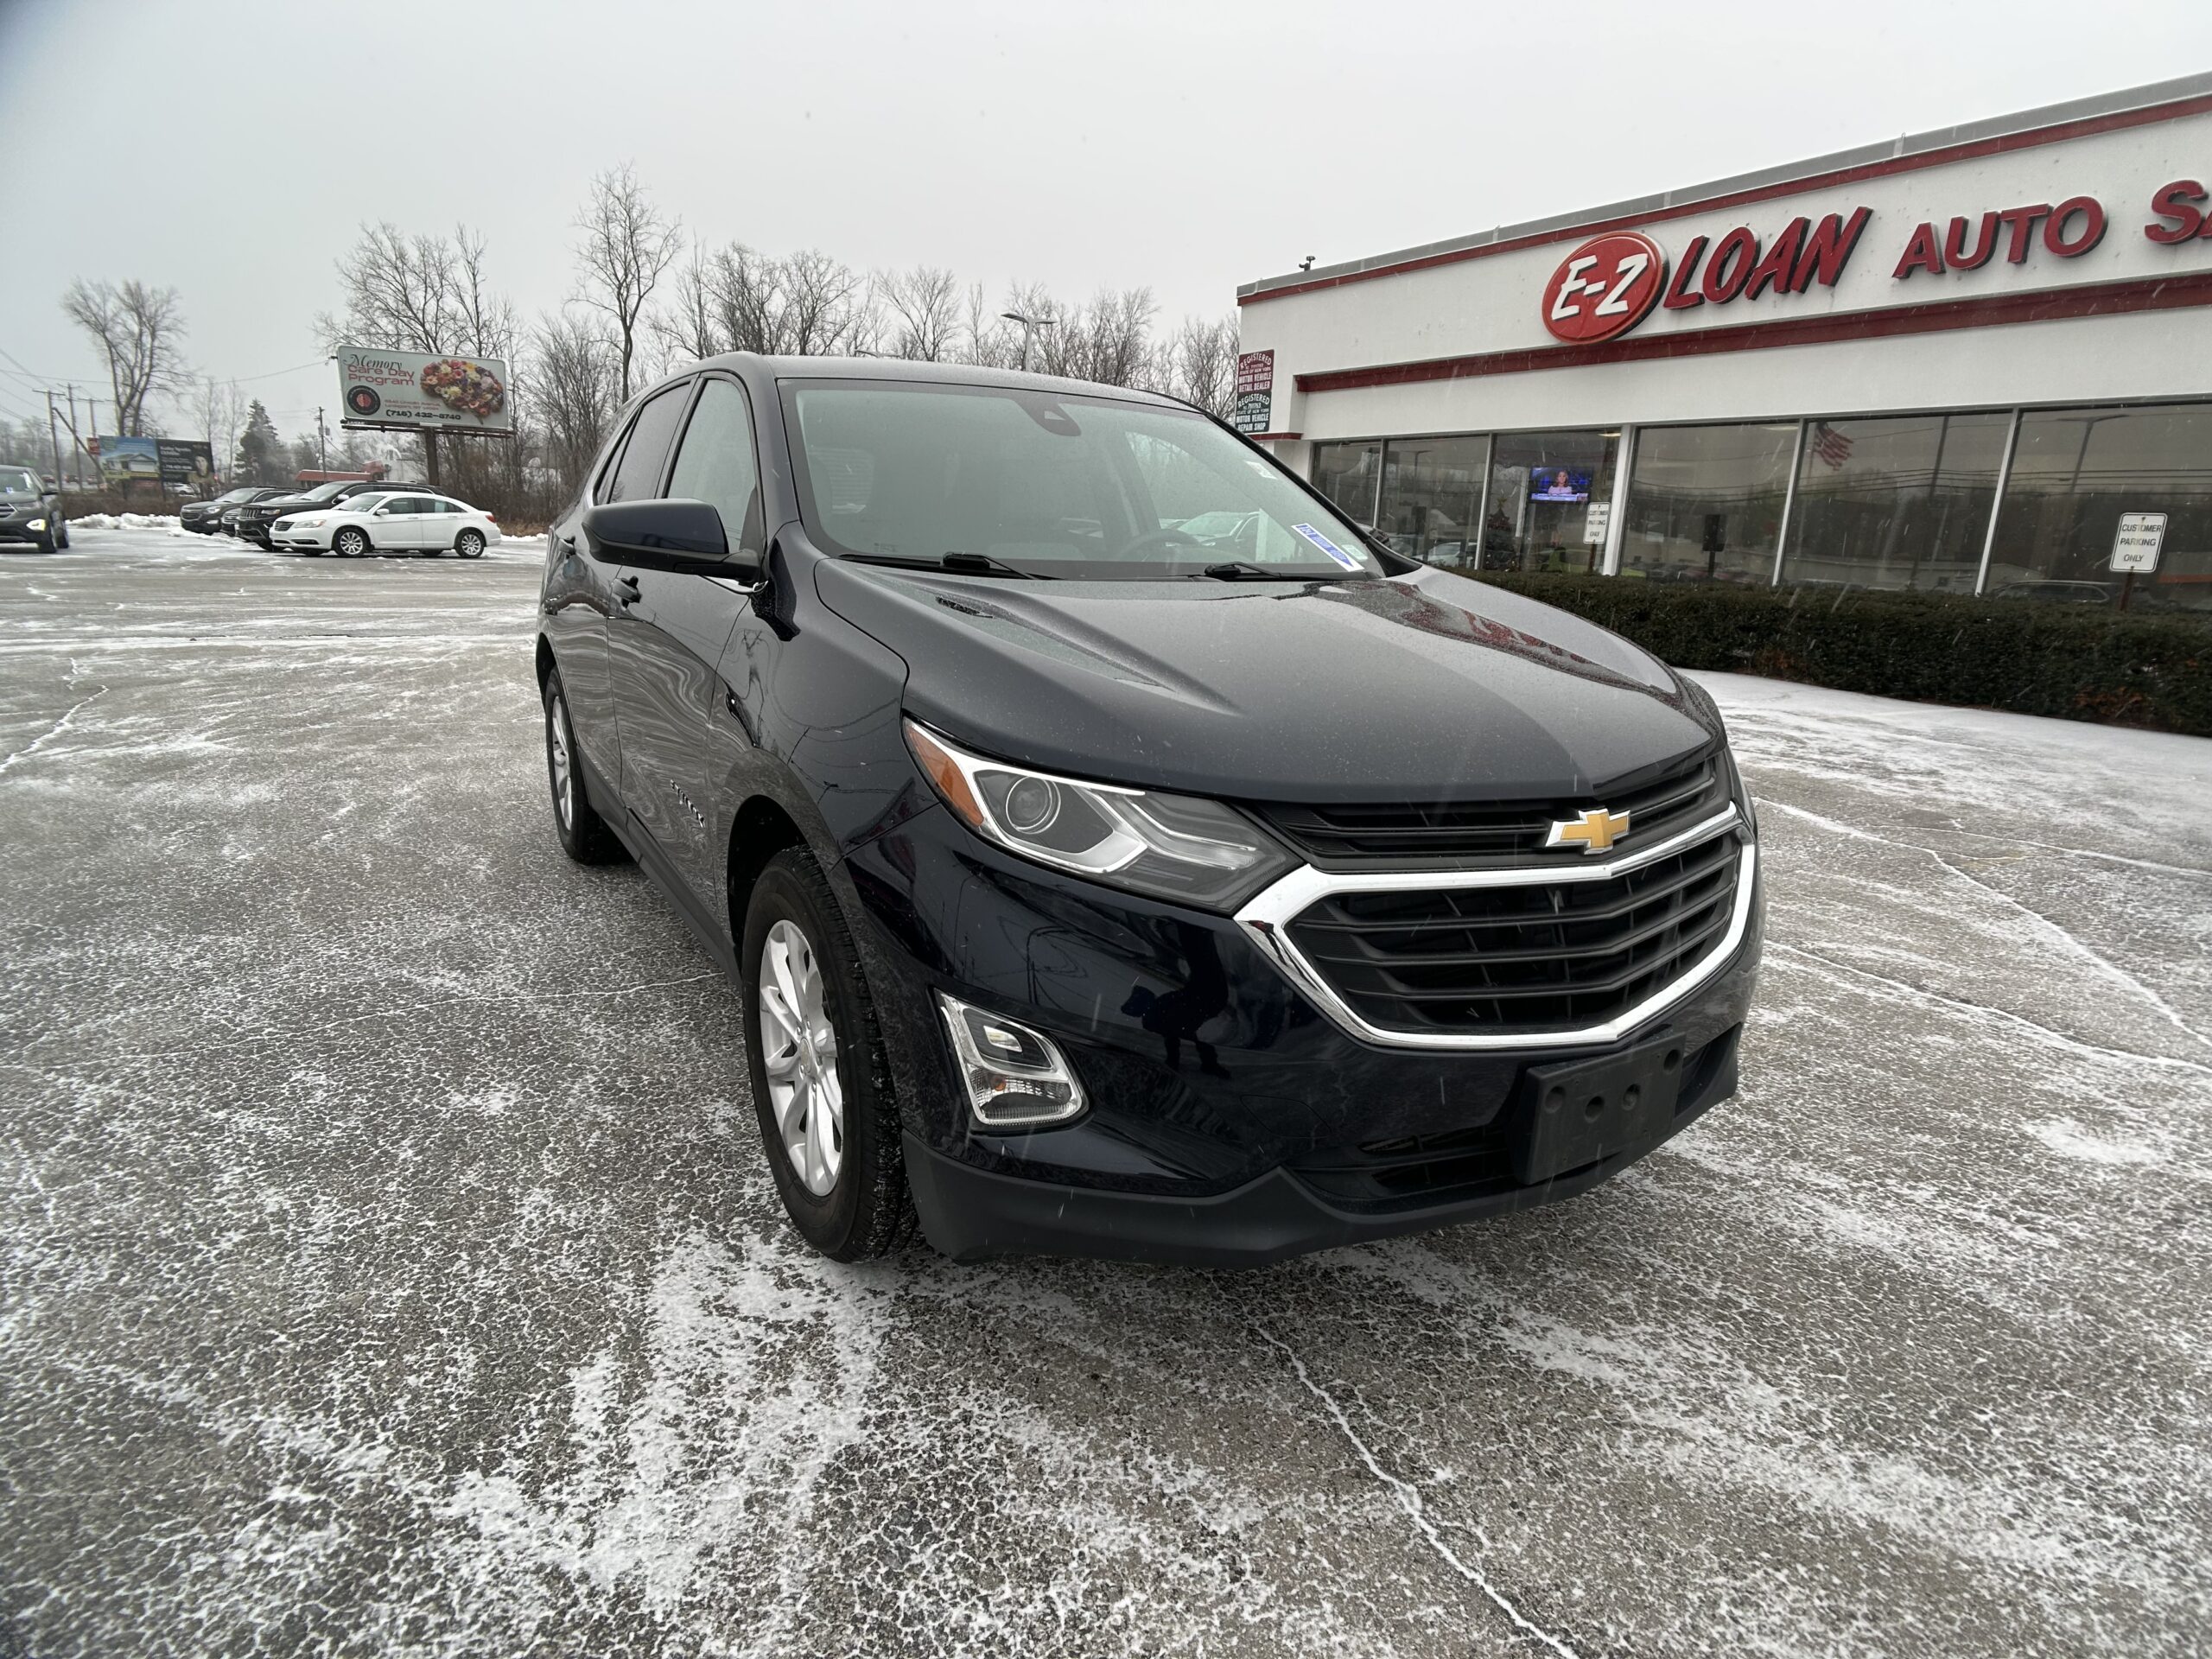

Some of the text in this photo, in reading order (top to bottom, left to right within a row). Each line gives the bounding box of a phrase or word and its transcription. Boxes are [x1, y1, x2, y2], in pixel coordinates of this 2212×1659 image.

[1551, 180, 2212, 321] E-Z LOAN AUTO S
[342, 353, 403, 370] Memory
[1240, 353, 1272, 369] REGISTERED
[347, 365, 415, 380] Care Day
[1238, 372, 1272, 384] MOTOR VEHICLE
[348, 373, 415, 385] Program
[1238, 381, 1270, 392] RETAIL DEALER
[1237, 393, 1270, 408] REGISTERED
[1236, 413, 1269, 423] MOTOR VEHICLE
[1237, 422, 1266, 431] REPAIR SHOP
[2121, 524, 2162, 532] CUSTOMER
[2120, 537, 2157, 546] PARKING
